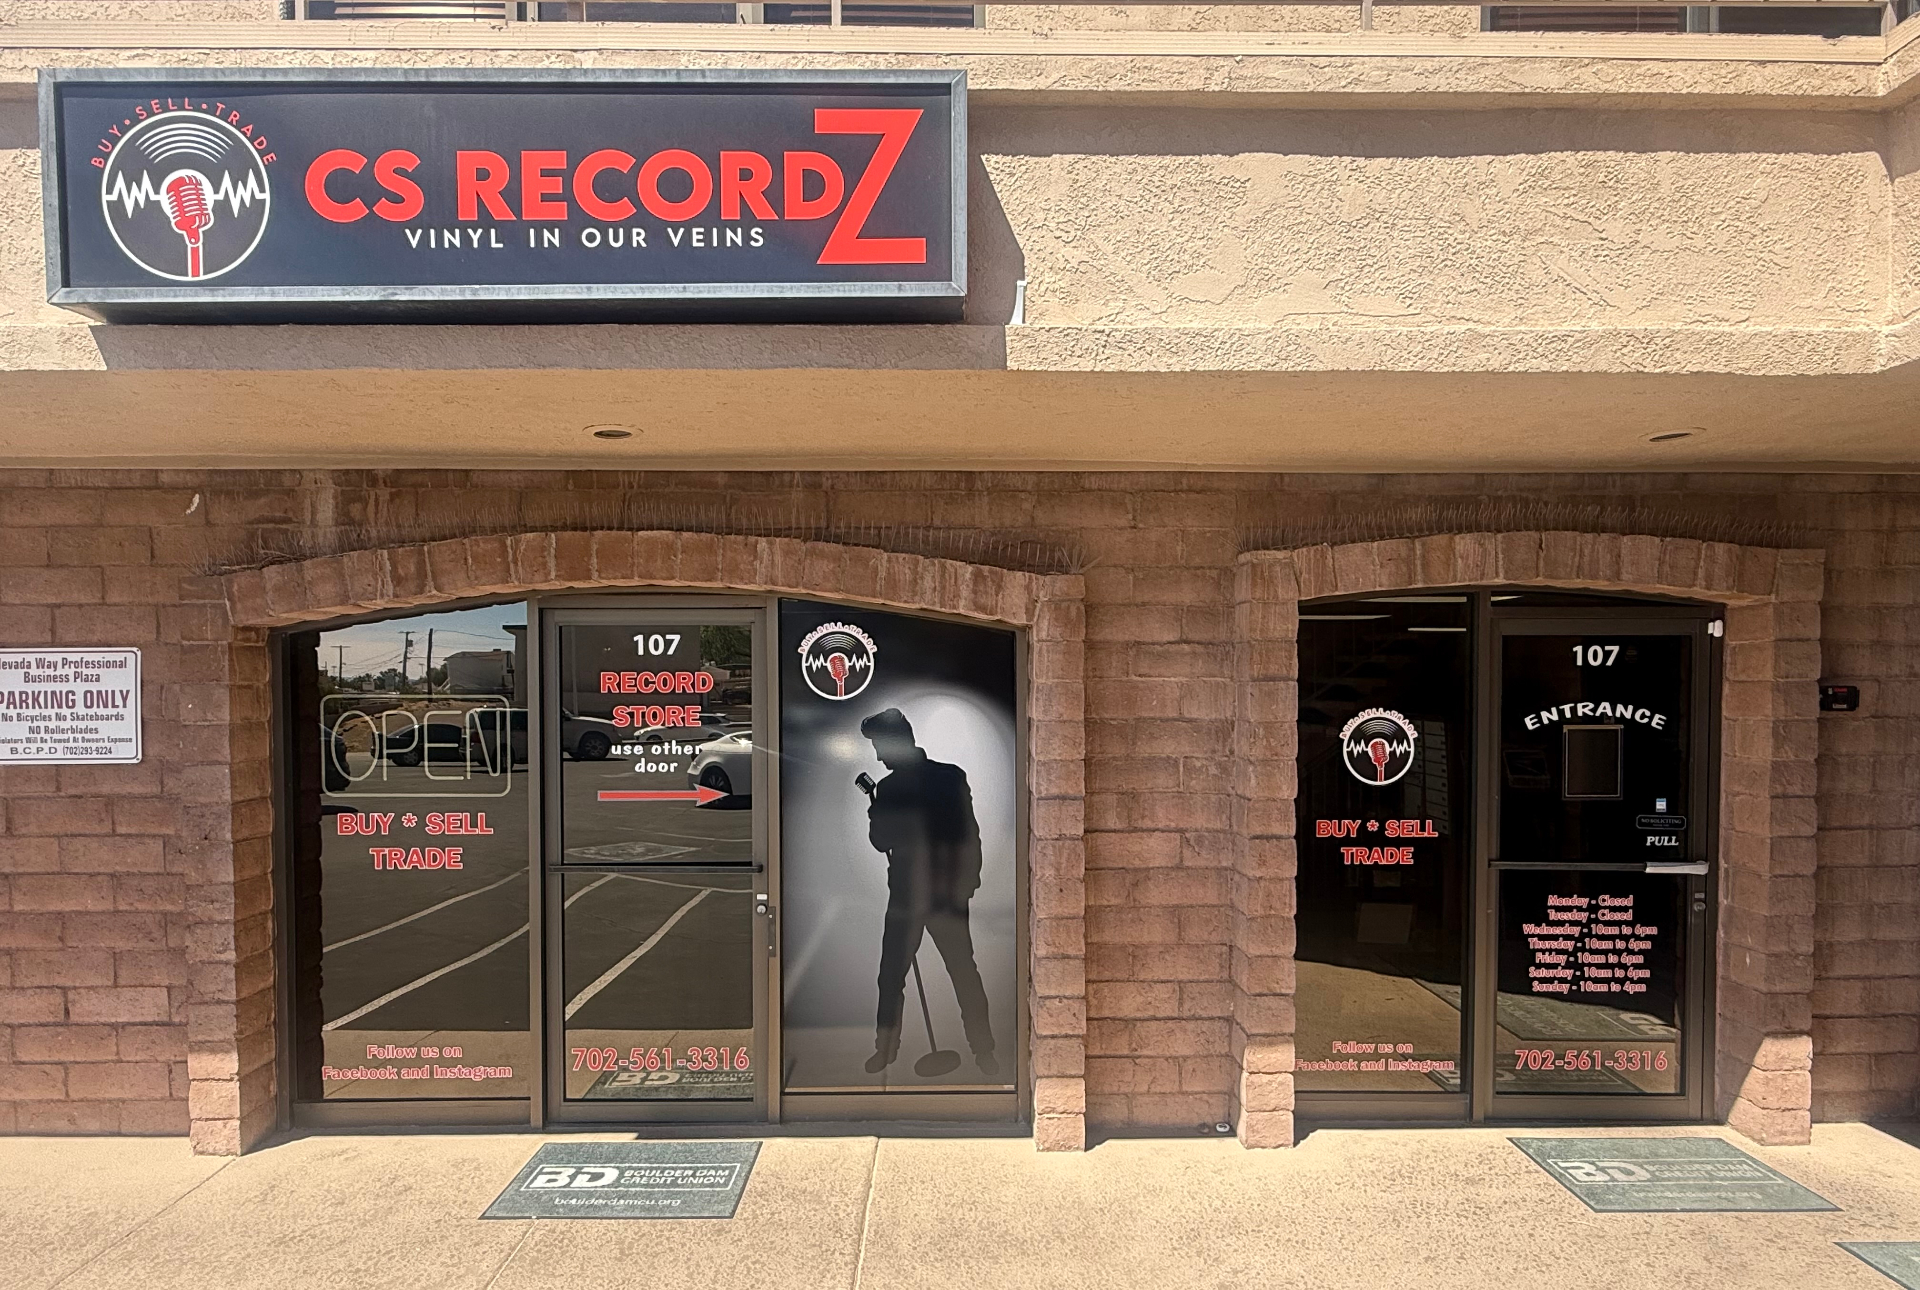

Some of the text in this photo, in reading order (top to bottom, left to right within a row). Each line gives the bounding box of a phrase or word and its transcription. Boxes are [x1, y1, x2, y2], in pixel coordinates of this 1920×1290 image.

[91, 98, 276, 168] BUY SELL TRADE
[305, 108, 927, 265] CS RECORDZ
[405, 227, 764, 248] VINYL IN OUR VEINS
[633, 634, 681, 656] 107
[1572, 645, 1620, 666] 107
[0, 657, 127, 672] evada Way Professional
[24, 671, 100, 683] Business Plaza
[600, 672, 714, 694] RECORD
[83, 689, 130, 709] ONLY
[2, 711, 124, 724] No Bicycles No Skateboards
[613, 705, 701, 727] STORE
[1524, 702, 1667, 731] ENTRANCE
[28, 725, 99, 735] NO Rollerblades
[50, 736, 70, 744] Towed
[330, 709, 501, 782] OPEN
[611, 740, 703, 755] use other
[10, 746, 57, 755] B.C.P.D
[634, 758, 678, 773] door
[337, 813, 493, 835] BUY SELL
[1316, 820, 1438, 837] BUY SELL
[1645, 836, 1679, 846] PULL
[370, 847, 463, 870] TRADE
[1341, 847, 1414, 864] TRADE
[1547, 895, 1590, 908] Monday
[1598, 895, 1633, 906] Closed
[1547, 909, 1589, 922] Tuesday
[1597, 909, 1633, 921] Closed
[1522, 923, 1581, 937] Wednesday
[1590, 924, 1619, 935] 10am
[1621, 924, 1632, 935] to
[1634, 924, 1658, 937] 6pm
[1528, 937, 1575, 951] Thursday
[1584, 938, 1613, 949] 10am
[1615, 939, 1626, 949] to
[1628, 938, 1651, 951] 6pm
[1535, 952, 1567, 966] Friday
[1577, 952, 1606, 964] 10am
[1608, 953, 1618, 963] to
[1620, 952, 1644, 966] 6pm
[1528, 966, 1574, 980] Saturday
[1583, 967, 1612, 978] 10am
[1614, 967, 1625, 977] to
[1627, 967, 1650, 980] 6pm
[1532, 981, 1570, 994] Sunday
[1580, 981, 1608, 992] 10am
[1610, 981, 1621, 992] to
[1623, 981, 1646, 994] 4pm
[366, 1044, 463, 1059] Follow us on
[1332, 1040, 1413, 1054] Follow us on
[572, 1047, 750, 1071] 702-561-3316
[1294, 1058, 1454, 1073] Facebook and Instagram
[1514, 1049, 1668, 1071] 702-561-3316
[322, 1065, 512, 1081] Facebook and Instagram
[529, 1168, 619, 1188] BD
[624, 1169, 729, 1177] BOULDER DAM
